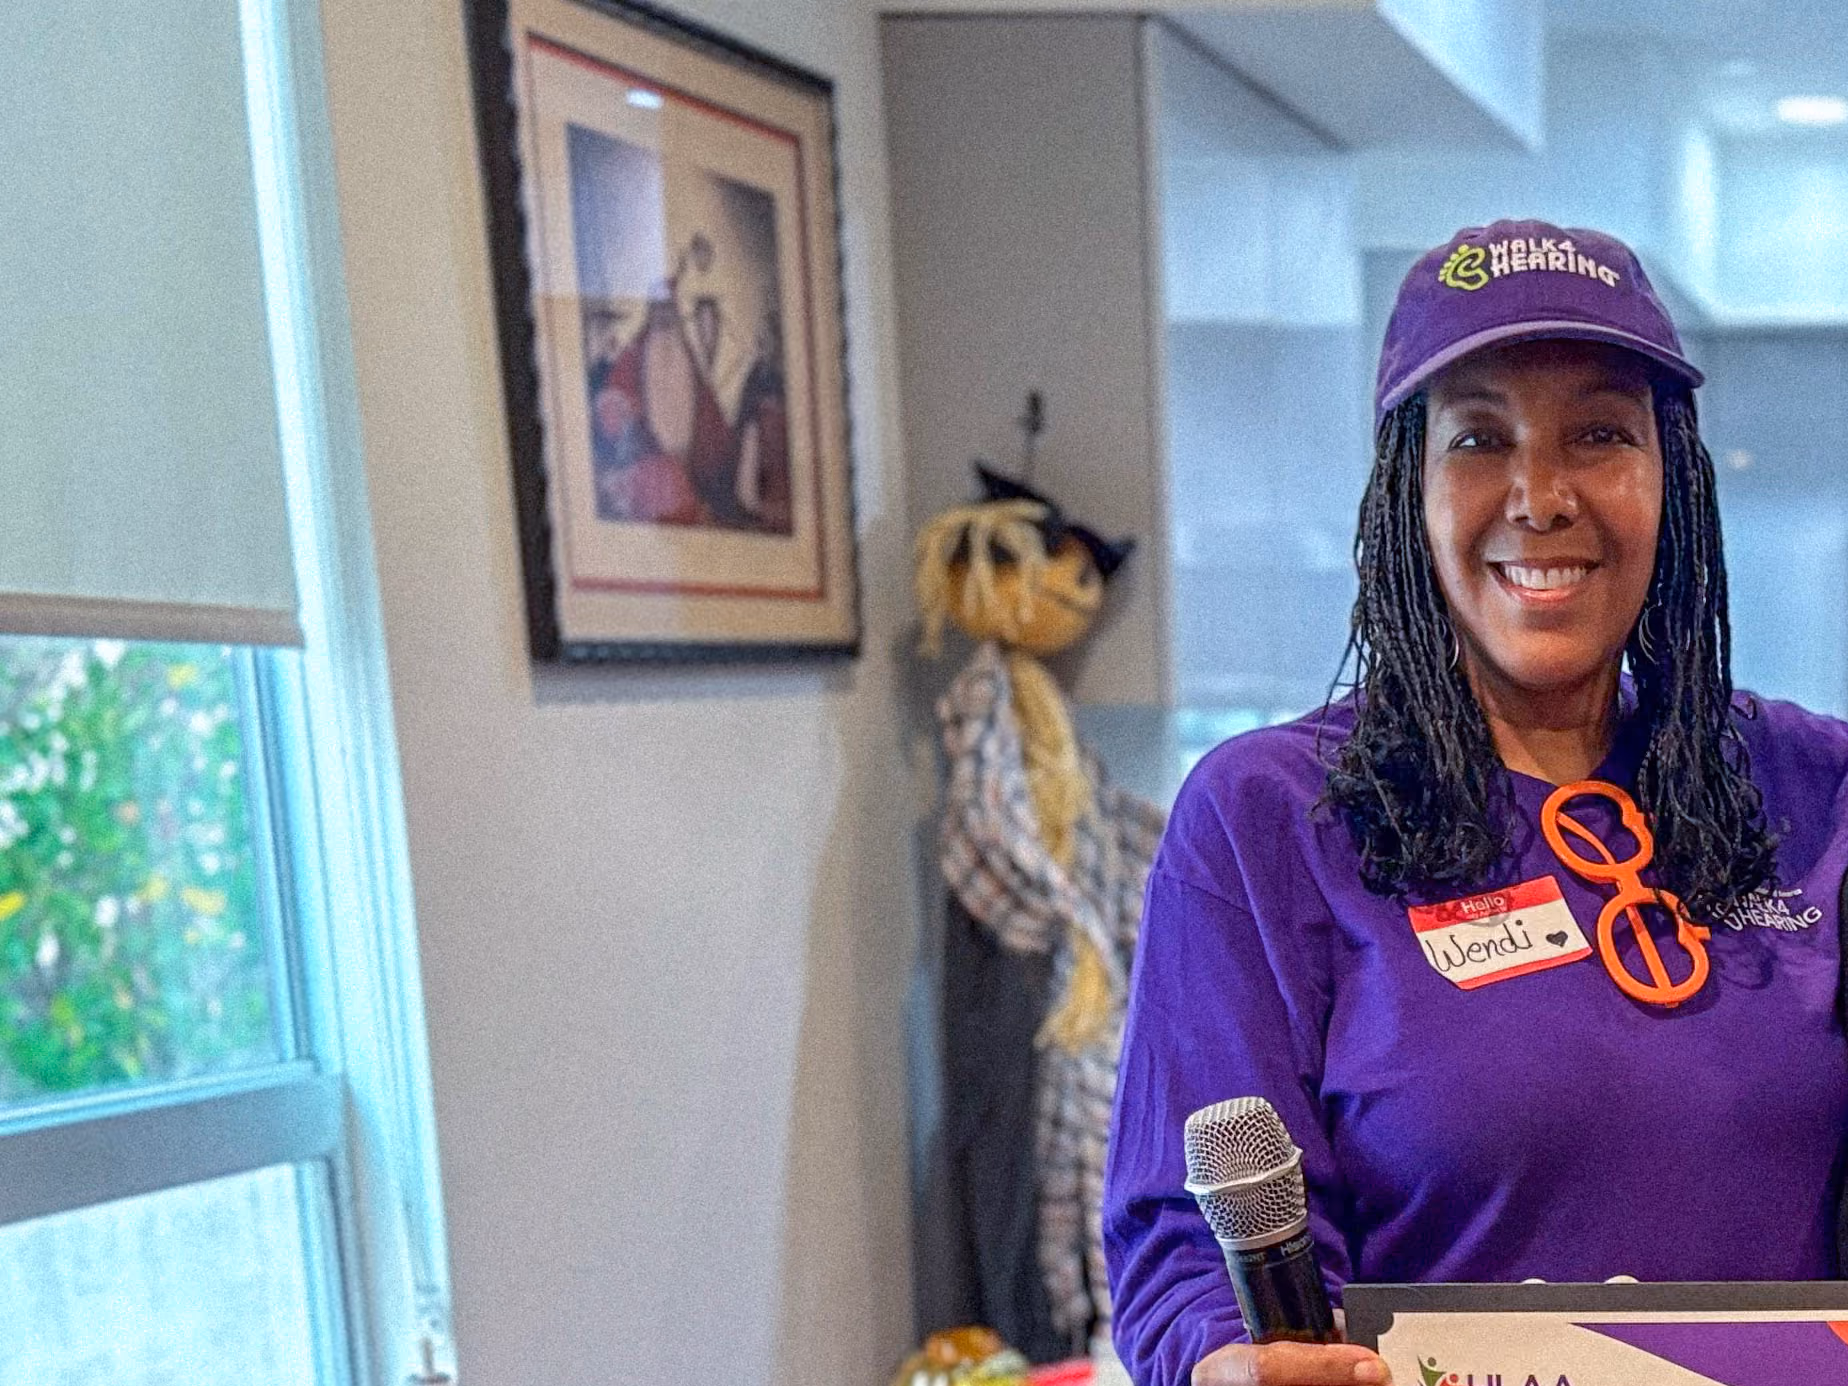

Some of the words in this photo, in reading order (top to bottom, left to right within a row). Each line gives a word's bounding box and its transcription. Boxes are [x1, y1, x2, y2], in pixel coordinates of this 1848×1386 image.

[1490, 251, 1621, 287] HEARING
[1737, 905, 1823, 931] HEARING
[1425, 919, 1533, 972] Wendi
